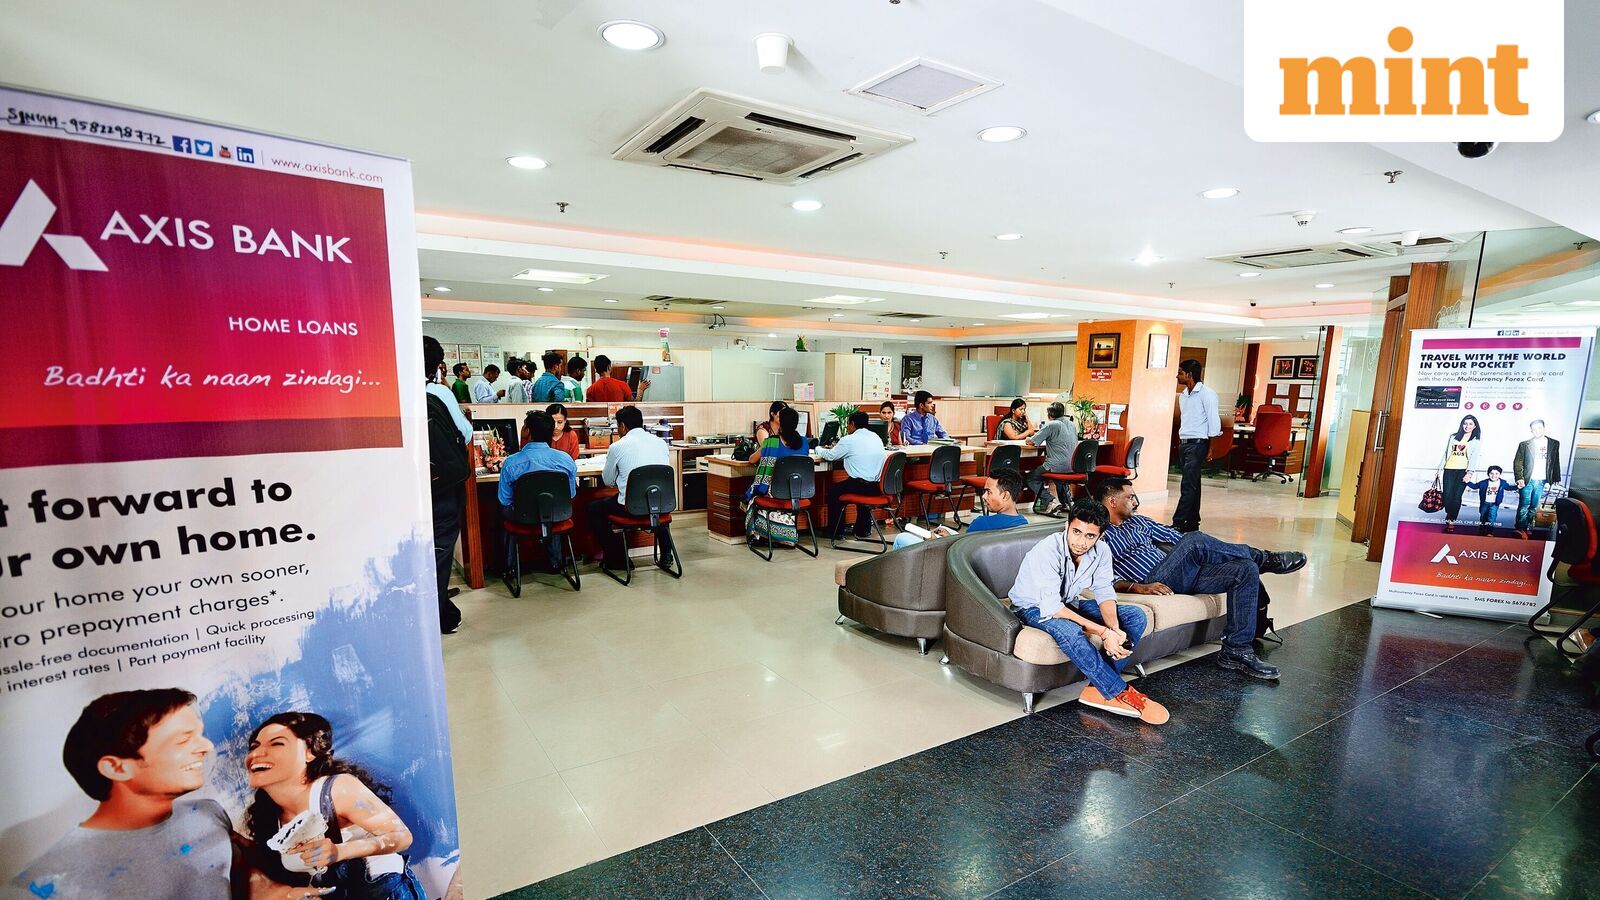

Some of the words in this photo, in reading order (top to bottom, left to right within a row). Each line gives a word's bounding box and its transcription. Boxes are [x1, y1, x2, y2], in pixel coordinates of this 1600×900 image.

[271, 156, 384, 183] www.axisbank.com
[100, 210, 215, 251] AXIS
[232, 225, 353, 264] BANK
[228, 316, 291, 334] HOME
[297, 320, 358, 336] LOANS
[1420, 353, 1461, 361] TRAVEL
[1465, 353, 1494, 361] WITH
[1498, 353, 1519, 361] THE
[1523, 353, 1567, 361] WORLD
[1420, 361, 1433, 369] IN
[1436, 361, 1467, 369] YOUR
[1471, 361, 1515, 369] POCKET
[43, 365, 147, 388] Badhti
[160, 365, 192, 390] ka
[203, 371, 271, 388] naam
[282, 368, 381, 394] zindagi...
[27, 477, 237, 524] forward
[250, 479, 293, 504] to
[51, 537, 161, 570] own
[176, 522, 317, 556] home.
[1458, 550, 1489, 560] AXIS
[1493, 552, 1532, 563] BANK
[54, 590, 125, 609] home
[132, 580, 182, 603] your
[190, 573, 233, 589] own
[241, 563, 310, 583] sooner,
[1511, 600, 1537, 608] 5676782
[0, 634, 31, 649] ro
[40, 605, 182, 646] prepayment
[77, 633, 190, 660] documentation
[206, 620, 246, 636] Quick
[250, 610, 315, 632] processing
[7, 669, 67, 692] interest
[72, 663, 111, 678] rates
[128, 655, 157, 668] Part
[161, 641, 221, 664] payment
[224, 634, 266, 648] facility
